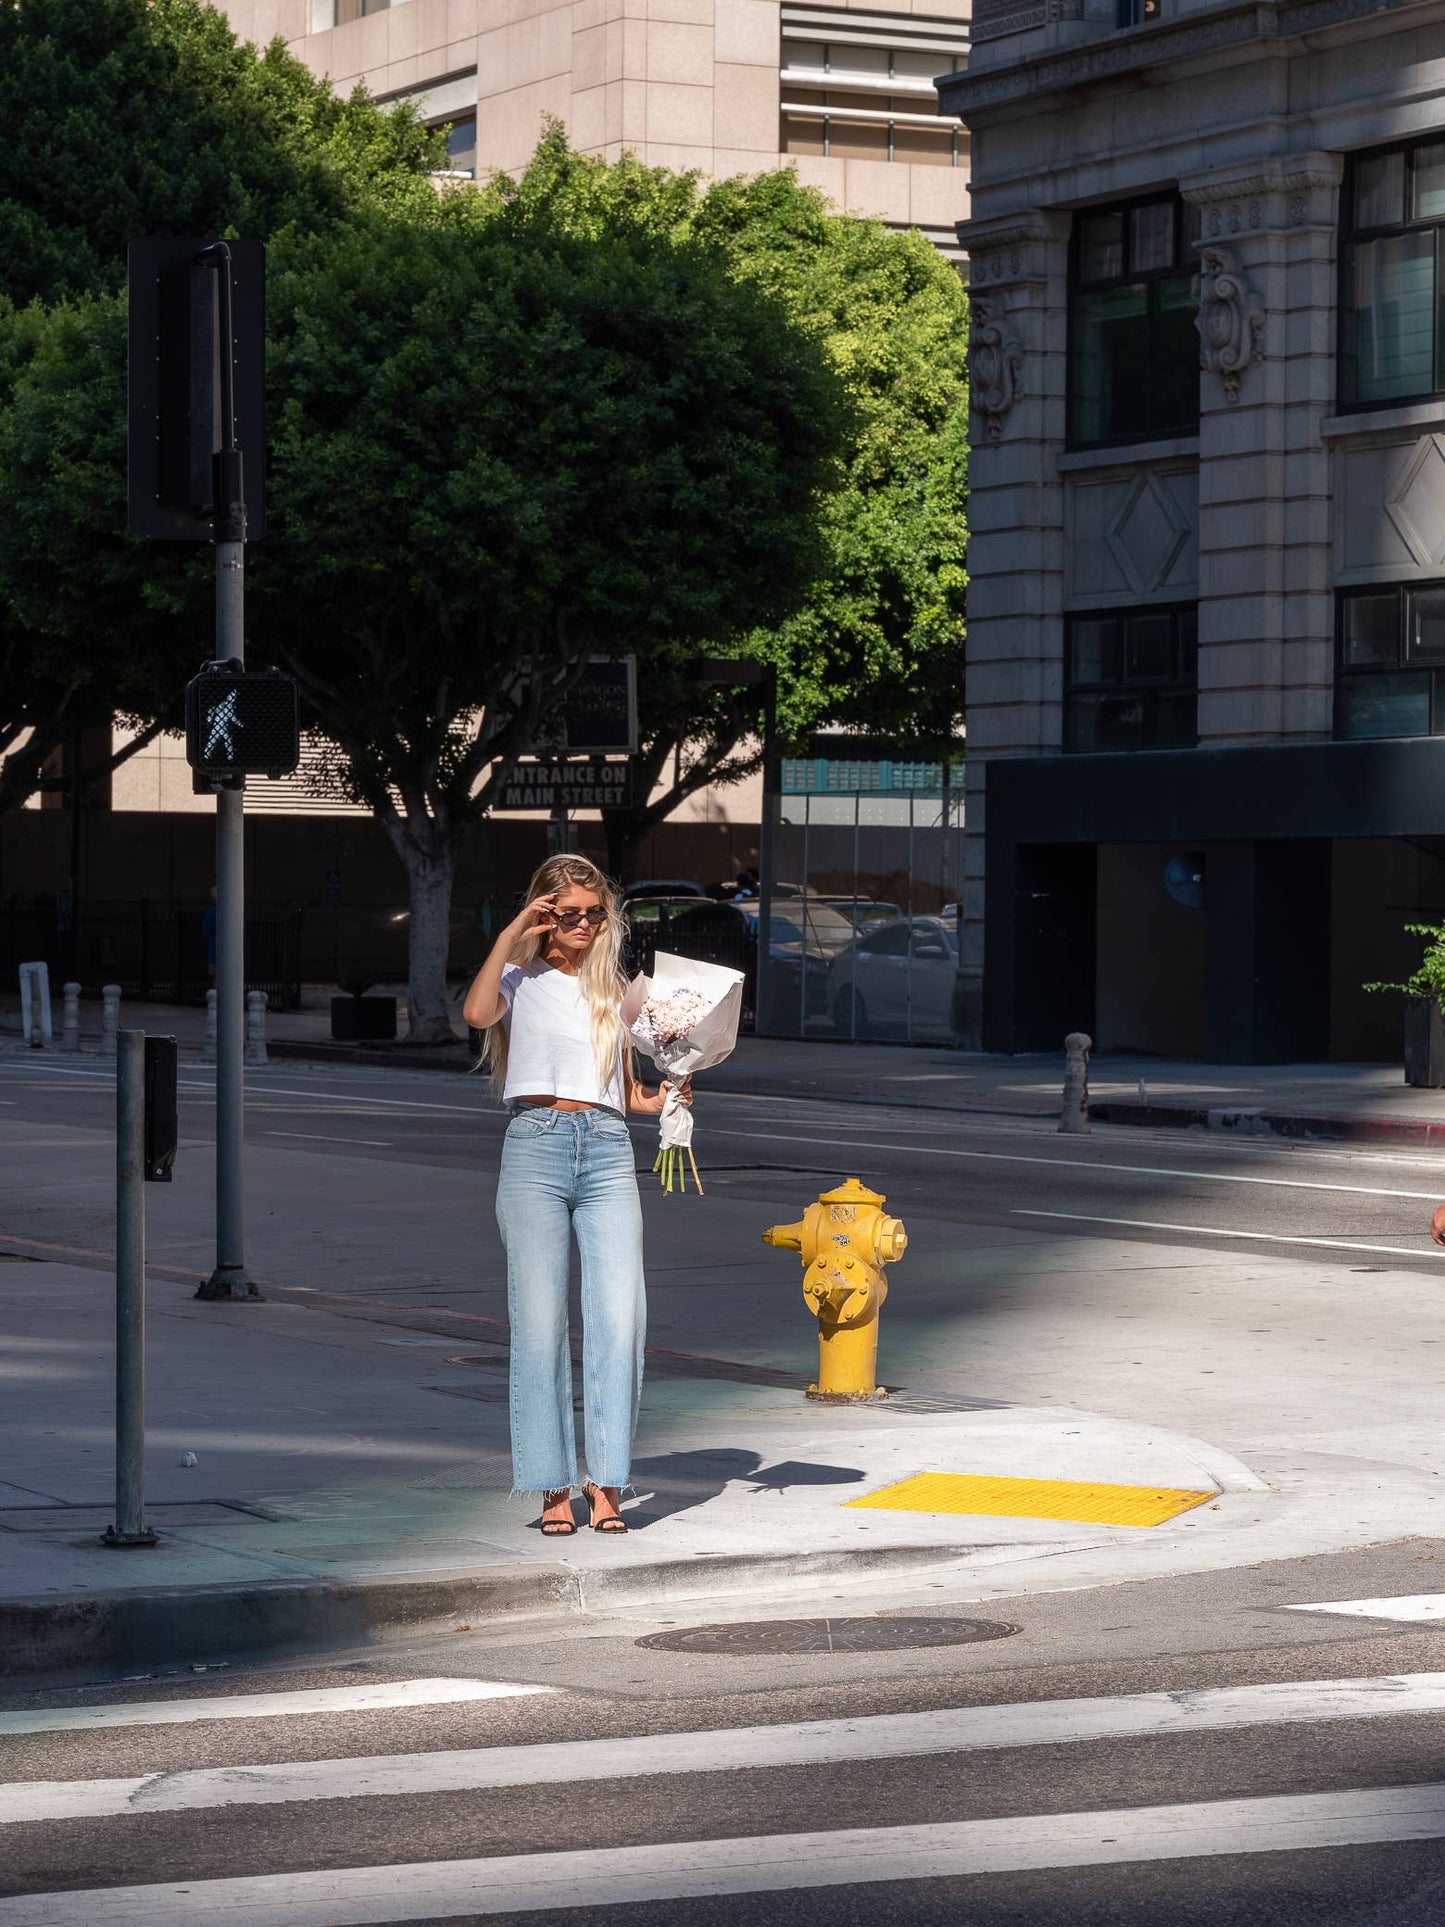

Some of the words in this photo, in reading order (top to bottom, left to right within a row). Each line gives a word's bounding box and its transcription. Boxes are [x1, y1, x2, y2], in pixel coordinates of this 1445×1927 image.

[507, 767, 595, 783] NTRANCE
[600, 767, 626, 783] ON
[506, 787, 554, 805] MAIN
[561, 787, 624, 804] STREET
